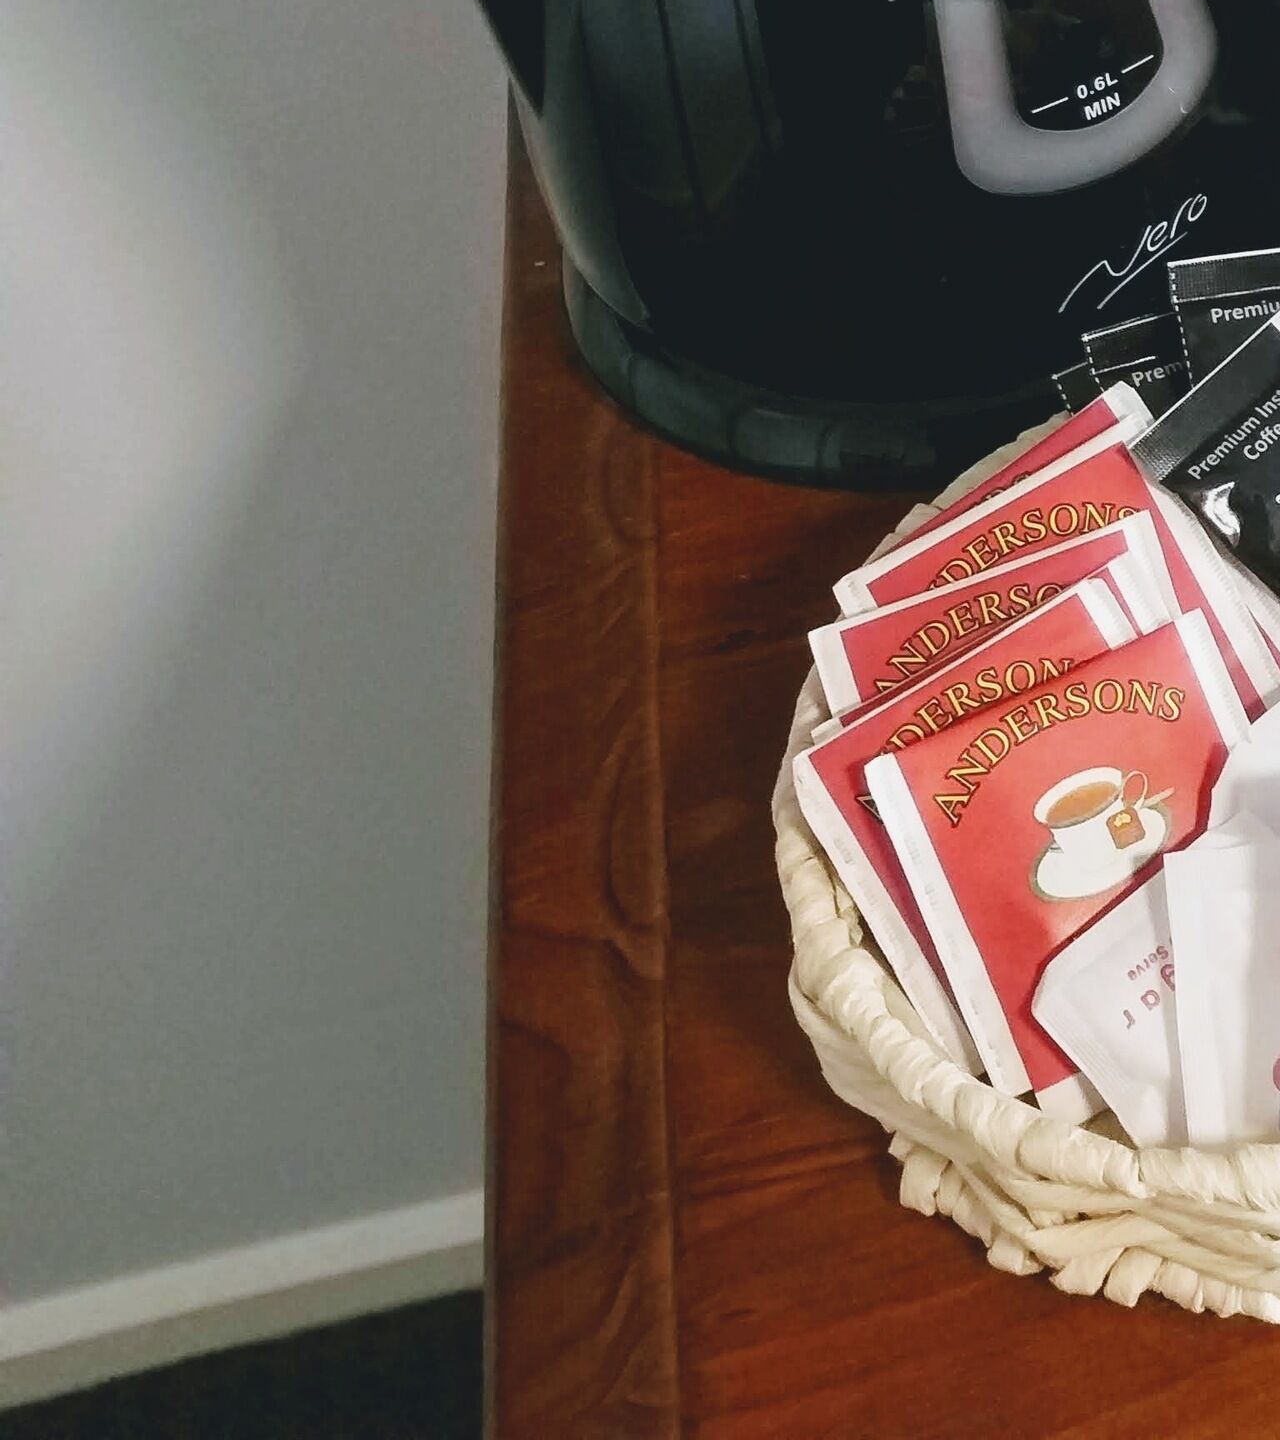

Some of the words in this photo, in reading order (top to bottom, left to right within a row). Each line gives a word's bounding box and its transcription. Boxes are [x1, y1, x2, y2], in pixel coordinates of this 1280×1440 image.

[1076, 72, 1119, 99] 0.6L
[1084, 92, 1121, 121] MIN
[1187, 416, 1261, 480] Premium
[932, 678, 1187, 828] ANDERSONS
